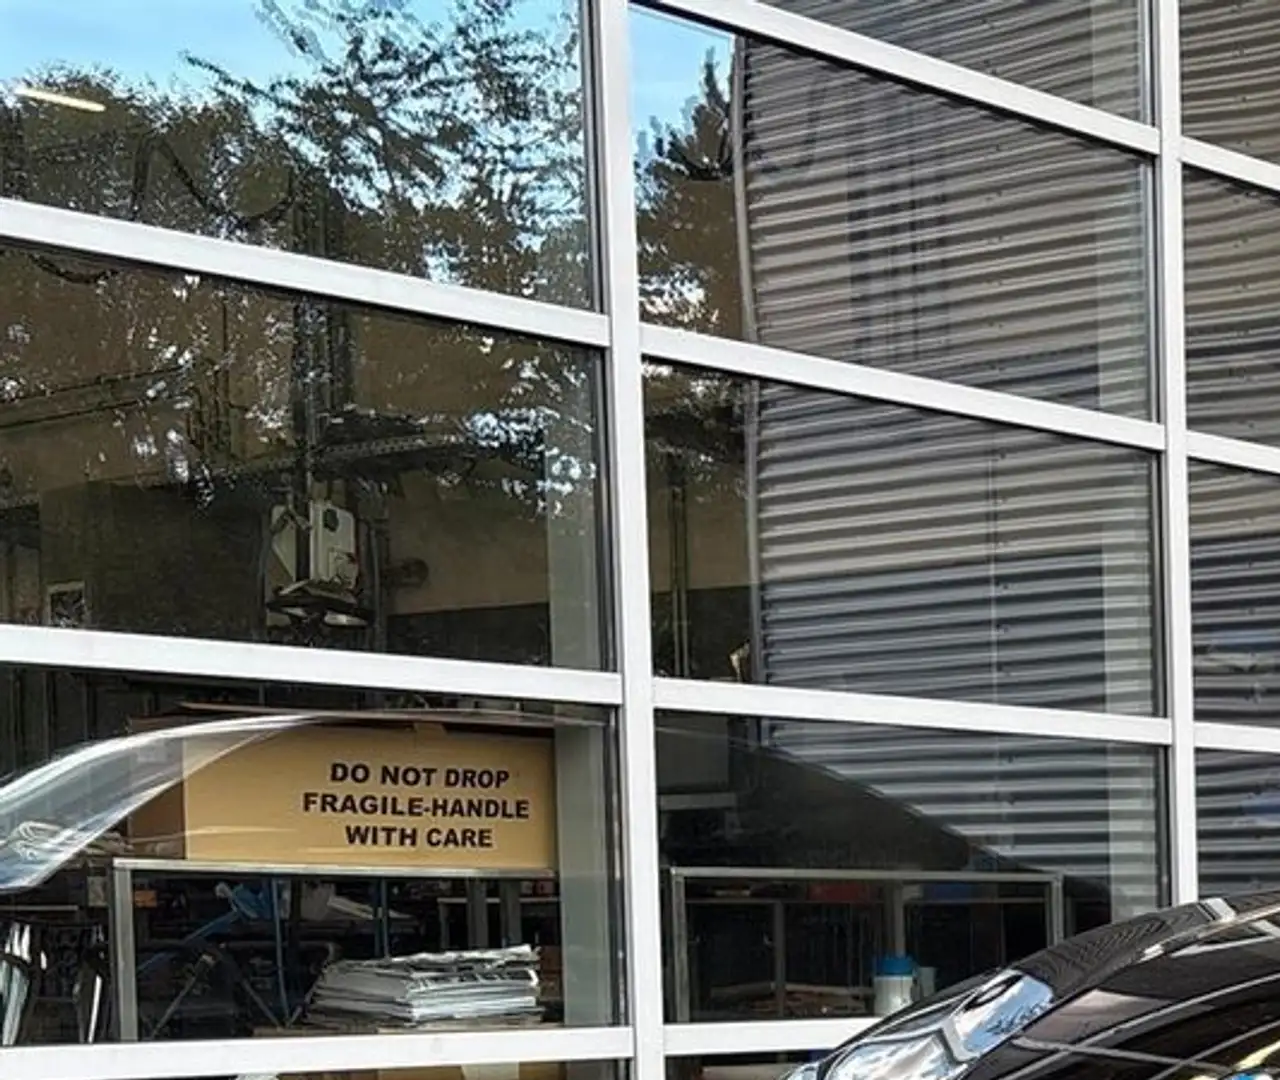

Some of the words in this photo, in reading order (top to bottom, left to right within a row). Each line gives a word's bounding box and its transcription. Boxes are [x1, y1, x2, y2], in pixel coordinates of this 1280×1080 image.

[331, 763, 370, 784] DO
[381, 765, 437, 787] NOT
[445, 768, 510, 789] DROP
[303, 792, 530, 819] FRAGILE-HANDLE
[346, 825, 417, 847] WITH
[427, 828, 493, 848] CARE
